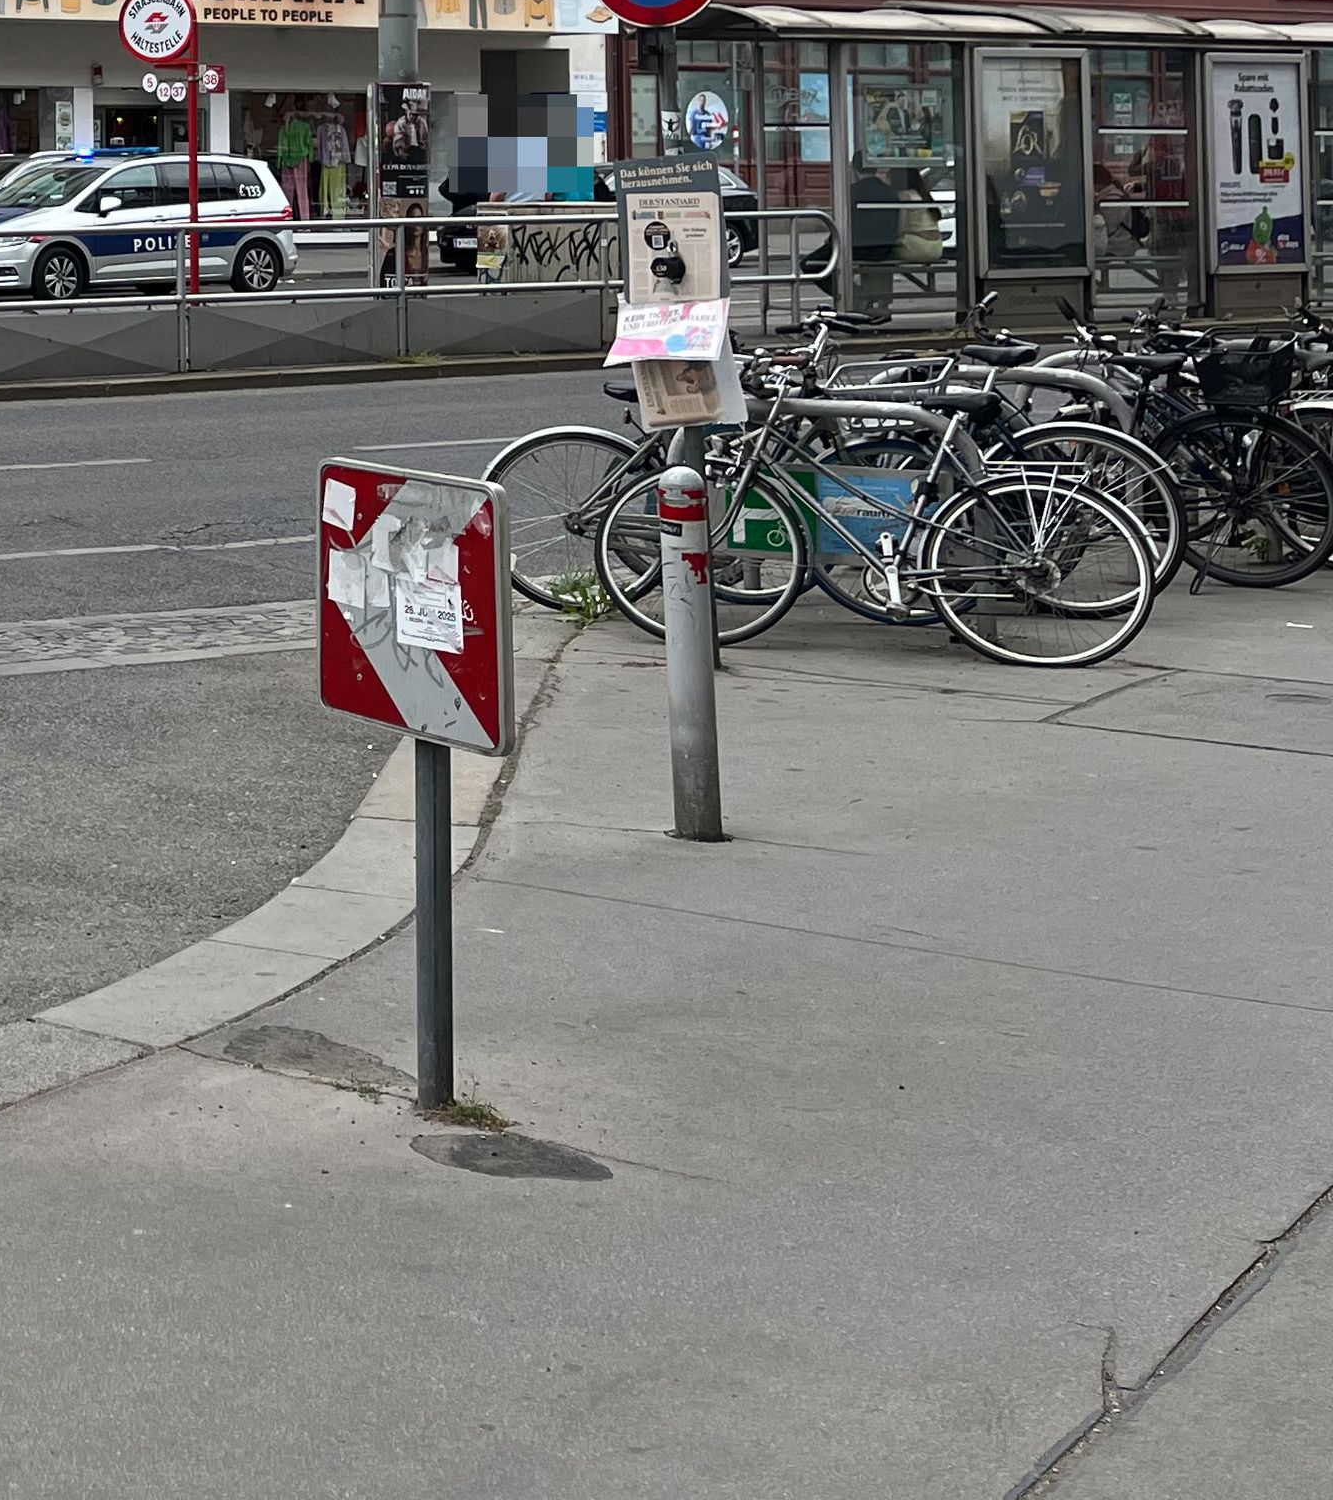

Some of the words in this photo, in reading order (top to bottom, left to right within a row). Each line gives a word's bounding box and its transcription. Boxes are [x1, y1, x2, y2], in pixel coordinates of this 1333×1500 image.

[203, 7, 256, 21] PEOPLE
[260, 8, 278, 22] TO
[282, 9, 333, 23] PEOPLE
[130, 30, 184, 54] HALTESTELLE
[147, 77, 153, 88] 5
[204, 73, 217, 85] 38
[159, 87, 169, 97] 12
[172, 86, 185, 97] 37
[620, 169, 637, 179] Das
[638, 166, 674, 176] können
[676, 163, 692, 173] Sie
[693, 160, 713, 172] sich
[621, 175, 693, 189] herausnehmen.
[246, 185, 261, 197] 133
[133, 237, 192, 252] POLIE
[437, 610, 457, 623] 2025
